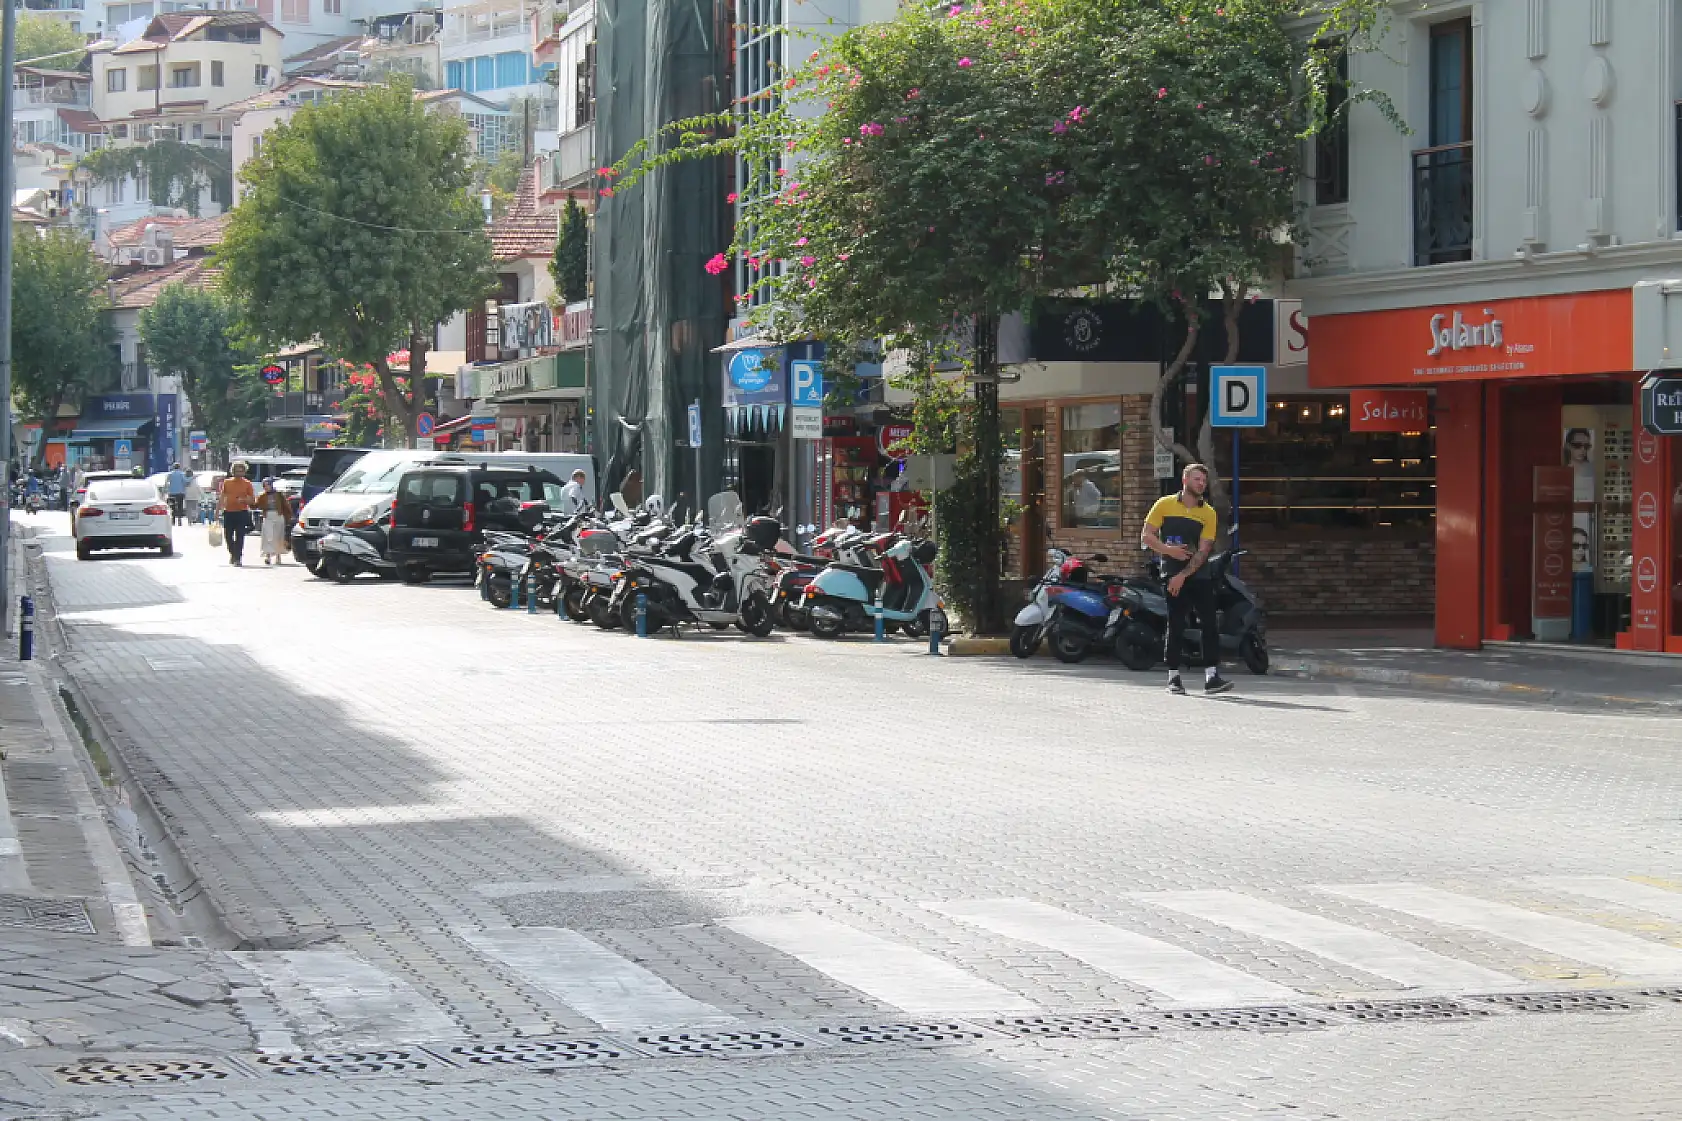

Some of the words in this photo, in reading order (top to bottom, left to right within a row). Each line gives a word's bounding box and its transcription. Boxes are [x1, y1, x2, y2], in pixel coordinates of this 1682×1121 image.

[1426, 308, 1503, 356] Solaris
[793, 364, 814, 401] P
[1226, 381, 1250, 412] D
[1360, 400, 1425, 421] Solaris
